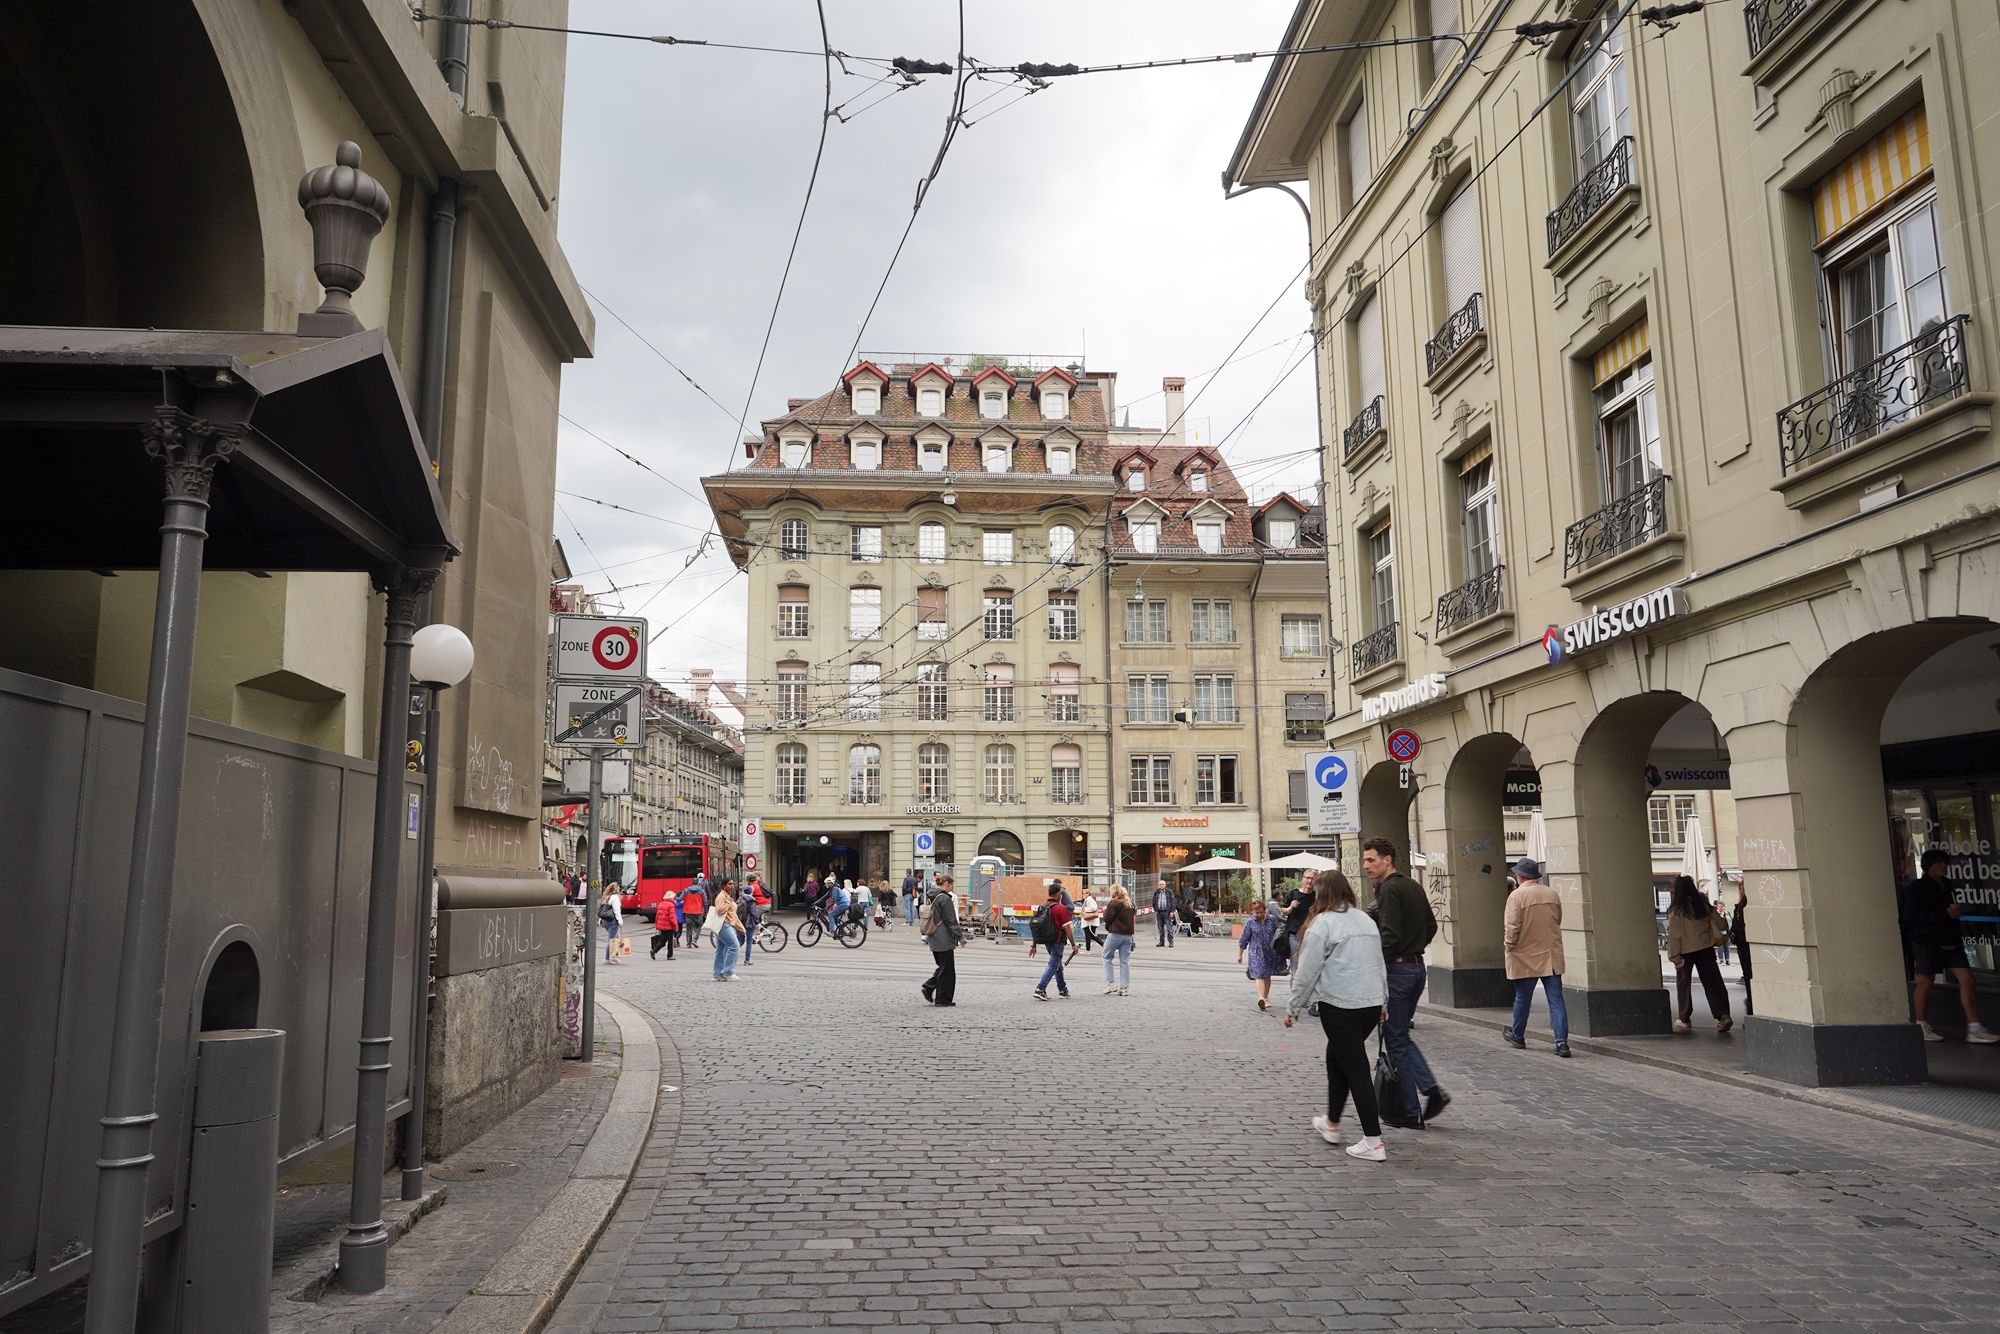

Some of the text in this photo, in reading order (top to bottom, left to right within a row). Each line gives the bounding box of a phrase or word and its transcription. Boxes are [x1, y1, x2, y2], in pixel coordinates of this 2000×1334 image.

[1563, 586, 1676, 654] swisscom
[561, 640, 625, 656] ZONE 30
[582, 689, 616, 701] ZONE
[616, 727, 626, 736] 20
[1664, 767, 1729, 780] swisscom
[906, 805, 961, 814] BUCHERER
[1162, 815, 1209, 827] Nomad
[464, 817, 523, 861] ANTIFA
[1743, 837, 1787, 855] ANTIFA
[1978, 934, 1991, 946] du
